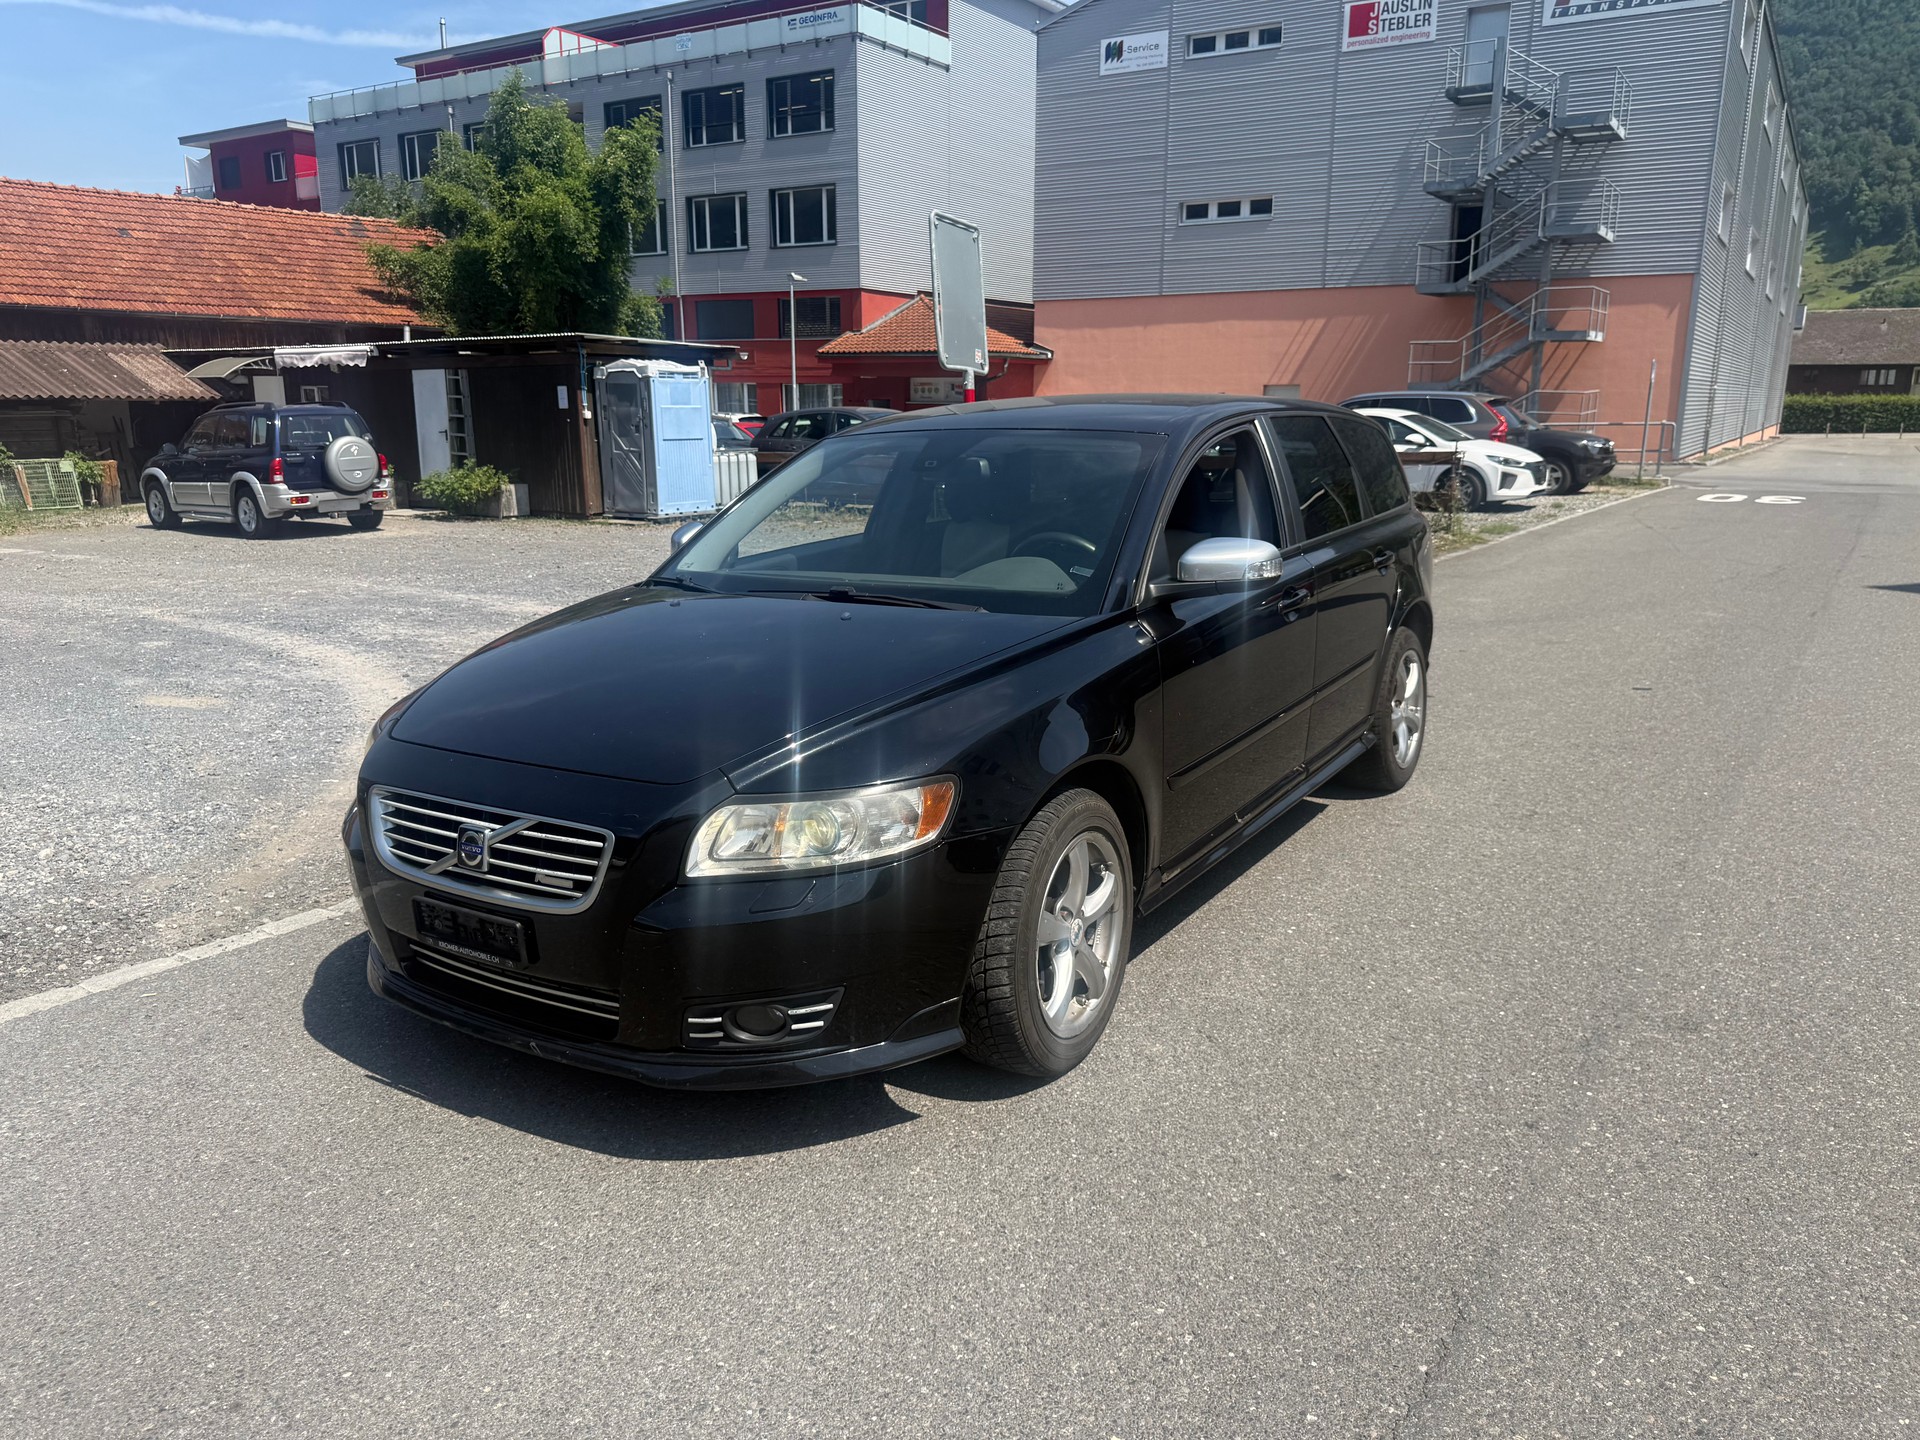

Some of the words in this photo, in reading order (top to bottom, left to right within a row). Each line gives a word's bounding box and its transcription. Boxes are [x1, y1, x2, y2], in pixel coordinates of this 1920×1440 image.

[798, 11, 838, 25] GEOINFRA
[1367, 12, 1432, 35] STEBLER
[1346, 35, 1390, 49] personalized
[1390, 31, 1431, 43] engineering
[461, 844, 482, 853] VOLVO
[438, 940, 501, 964] KROMER-AUTOMOBILE.CH
